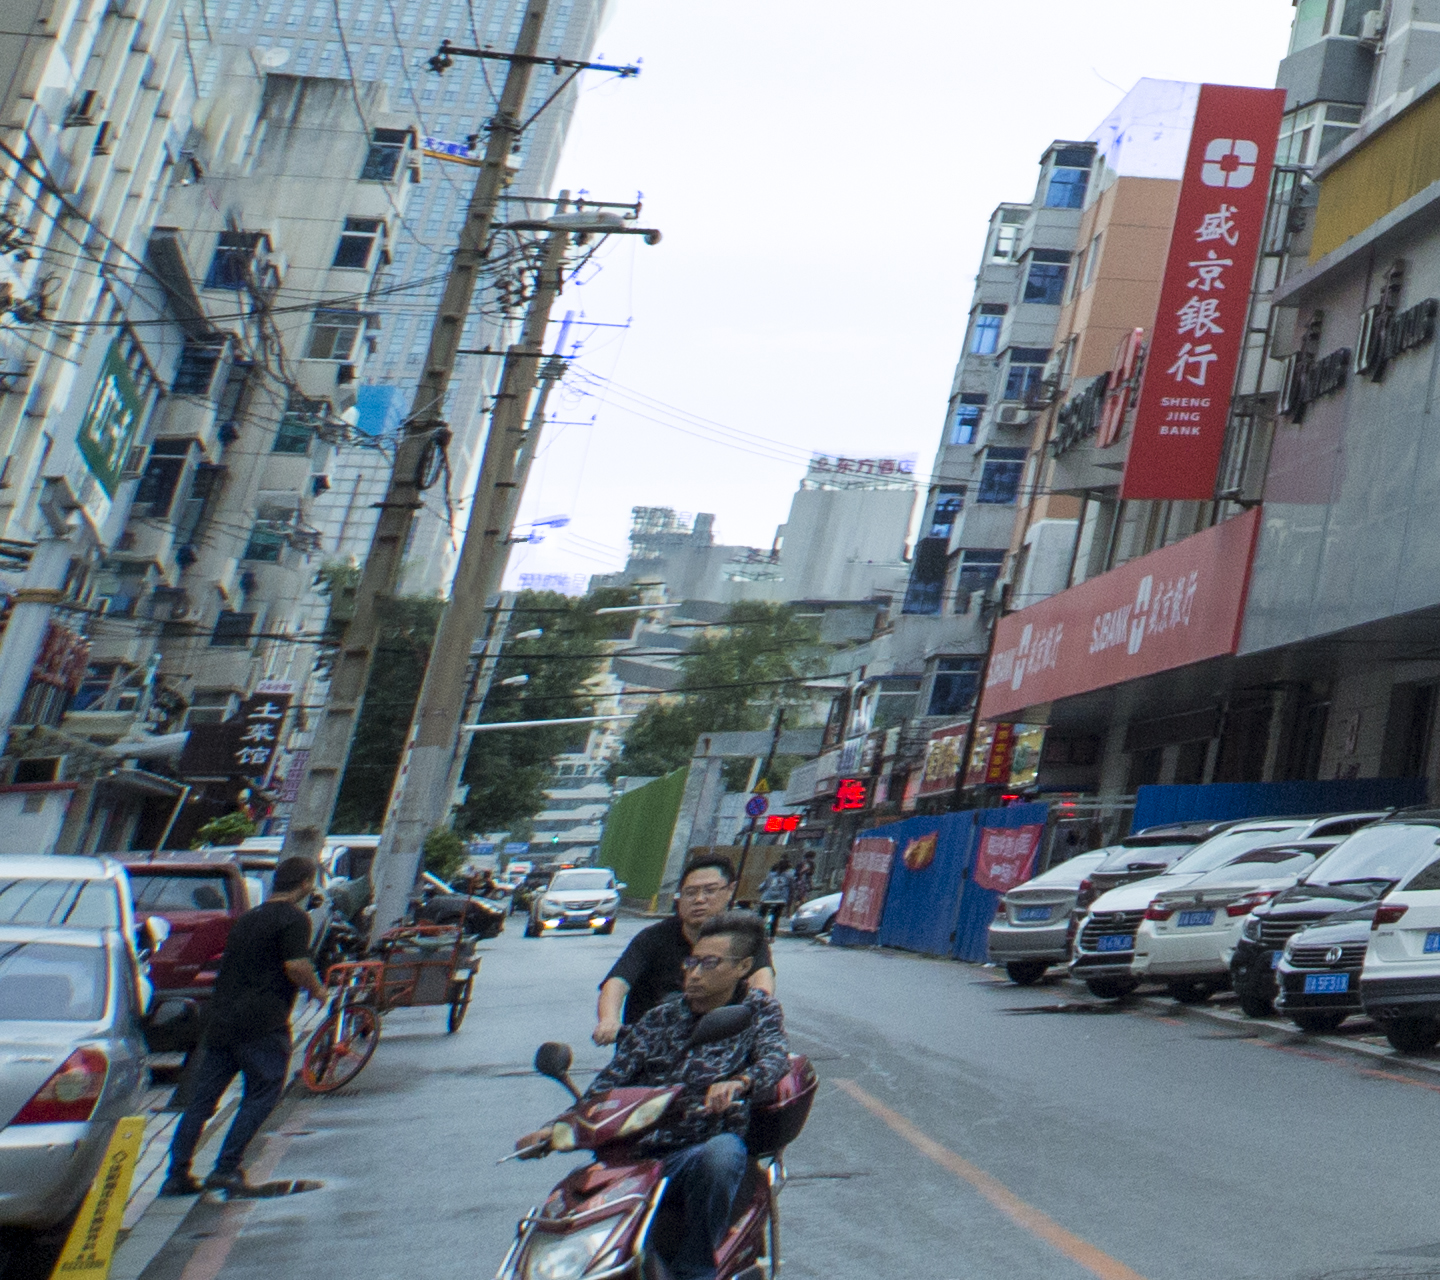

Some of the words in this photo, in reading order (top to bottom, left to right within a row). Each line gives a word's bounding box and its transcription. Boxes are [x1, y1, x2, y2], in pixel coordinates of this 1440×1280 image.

[1160, 396, 1211, 408] SHENG
[1165, 411, 1201, 422] JING
[1159, 425, 1201, 437] BANK
[235, 701, 283, 765] 土菜馆
